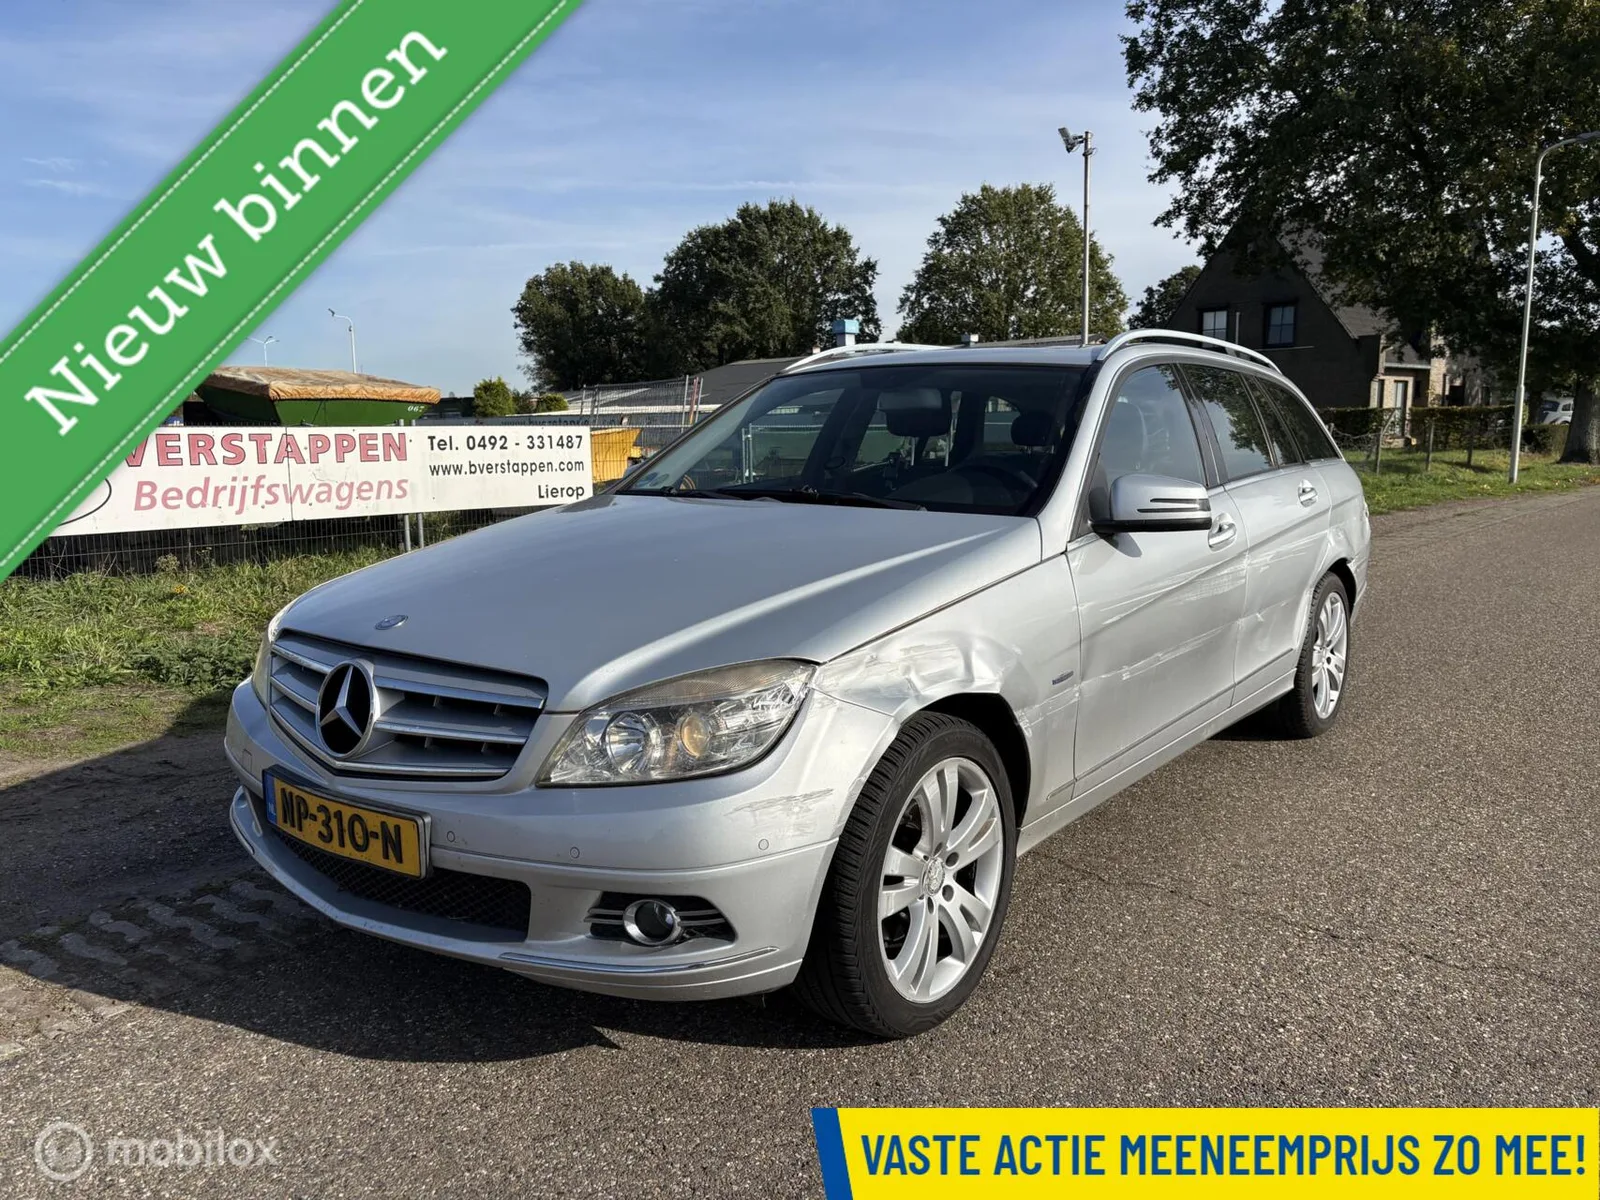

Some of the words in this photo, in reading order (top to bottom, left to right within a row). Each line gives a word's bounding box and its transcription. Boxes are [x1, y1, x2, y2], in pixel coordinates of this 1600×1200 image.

[428, 435, 459, 451] Tel.
[466, 435, 508, 451] 0492
[527, 435, 583, 450] 331487
[429, 459, 584, 476] www.bverstappen.com
[134, 474, 408, 515] Bedrijfswagens
[538, 484, 585, 500] Lierop
[280, 787, 403, 864] NP-310-N
